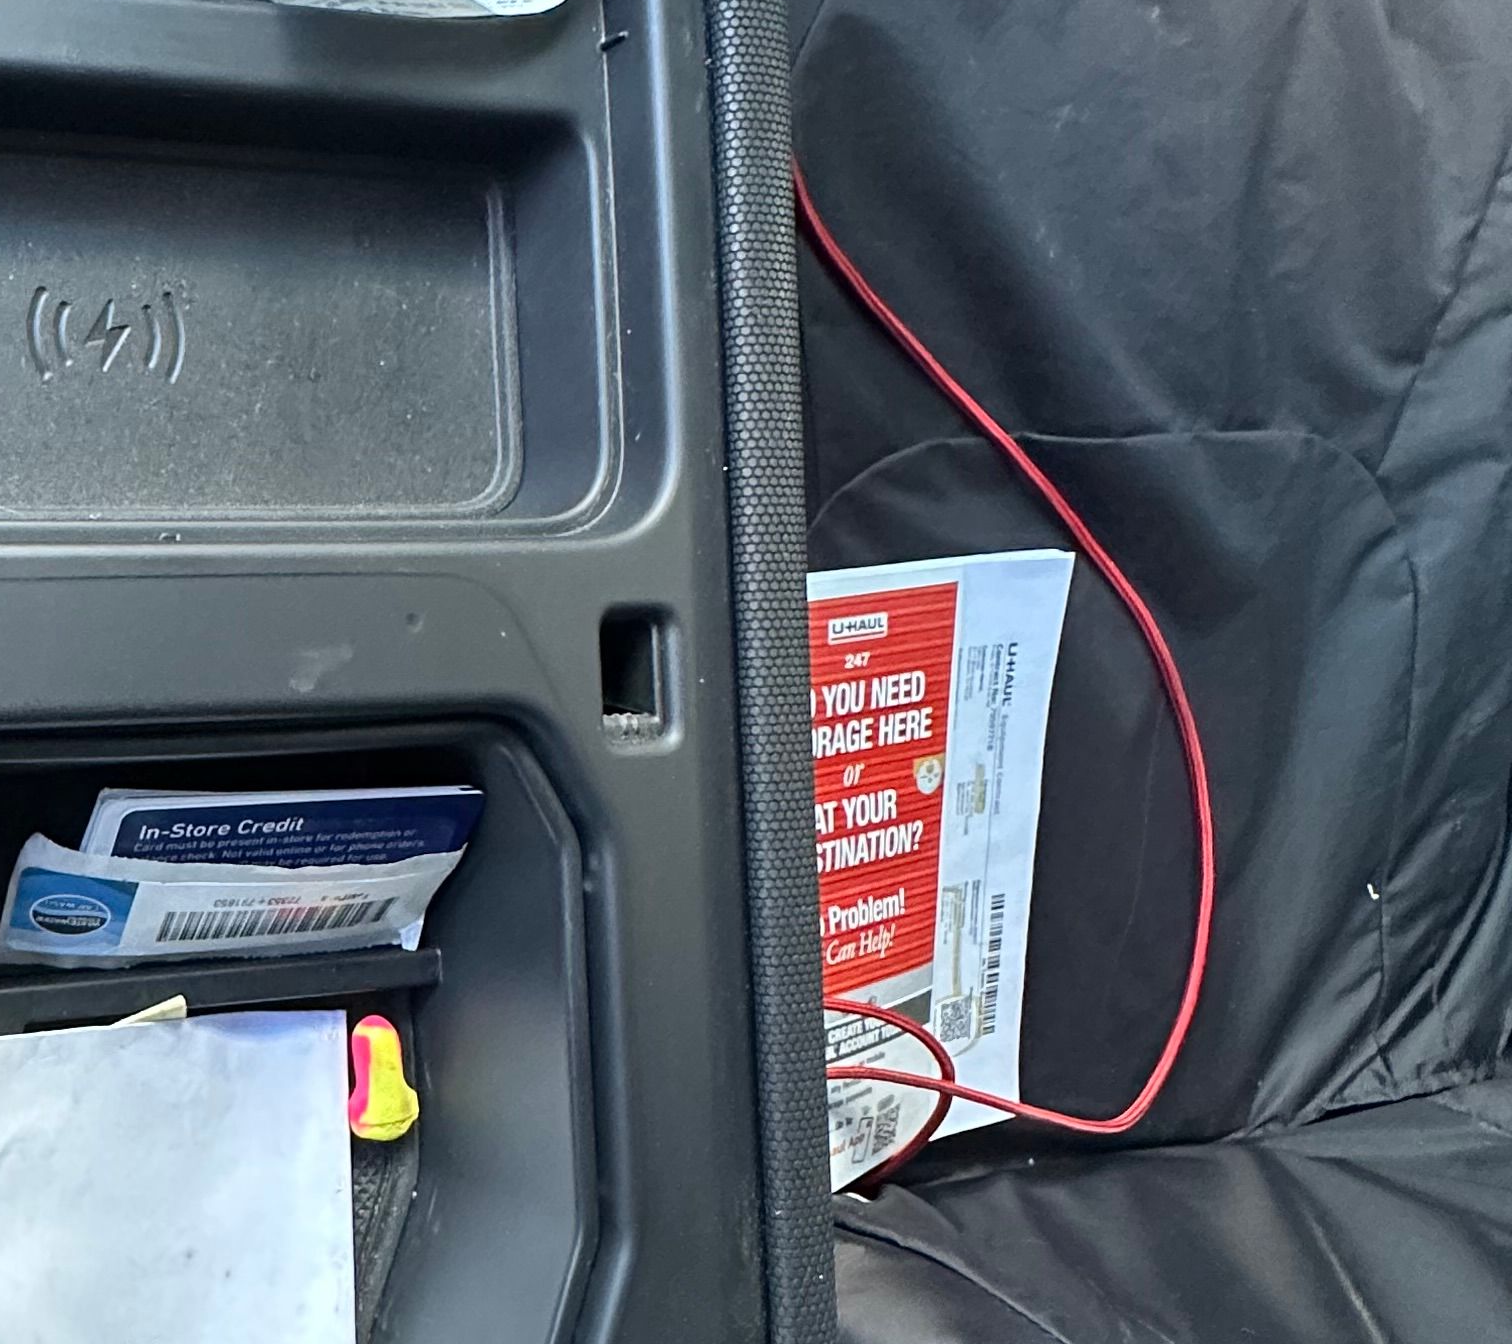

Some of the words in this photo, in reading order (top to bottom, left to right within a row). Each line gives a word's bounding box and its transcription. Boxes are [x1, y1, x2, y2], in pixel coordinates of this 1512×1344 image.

[843, 651, 871, 669] 247
[821, 679, 866, 718] YOU
[870, 670, 926, 711] NEED
[812, 717, 875, 759] RAGE
[877, 706, 934, 747] HERE
[842, 763, 866, 787] or
[138, 822, 232, 841] In-Store
[236, 816, 305, 835] Credit
[841, 788, 898, 830] YOUR
[815, 819, 924, 874] STINATION?
[827, 887, 906, 936] Problem!
[825, 938, 857, 966] Can
[858, 922, 896, 959] Help!
